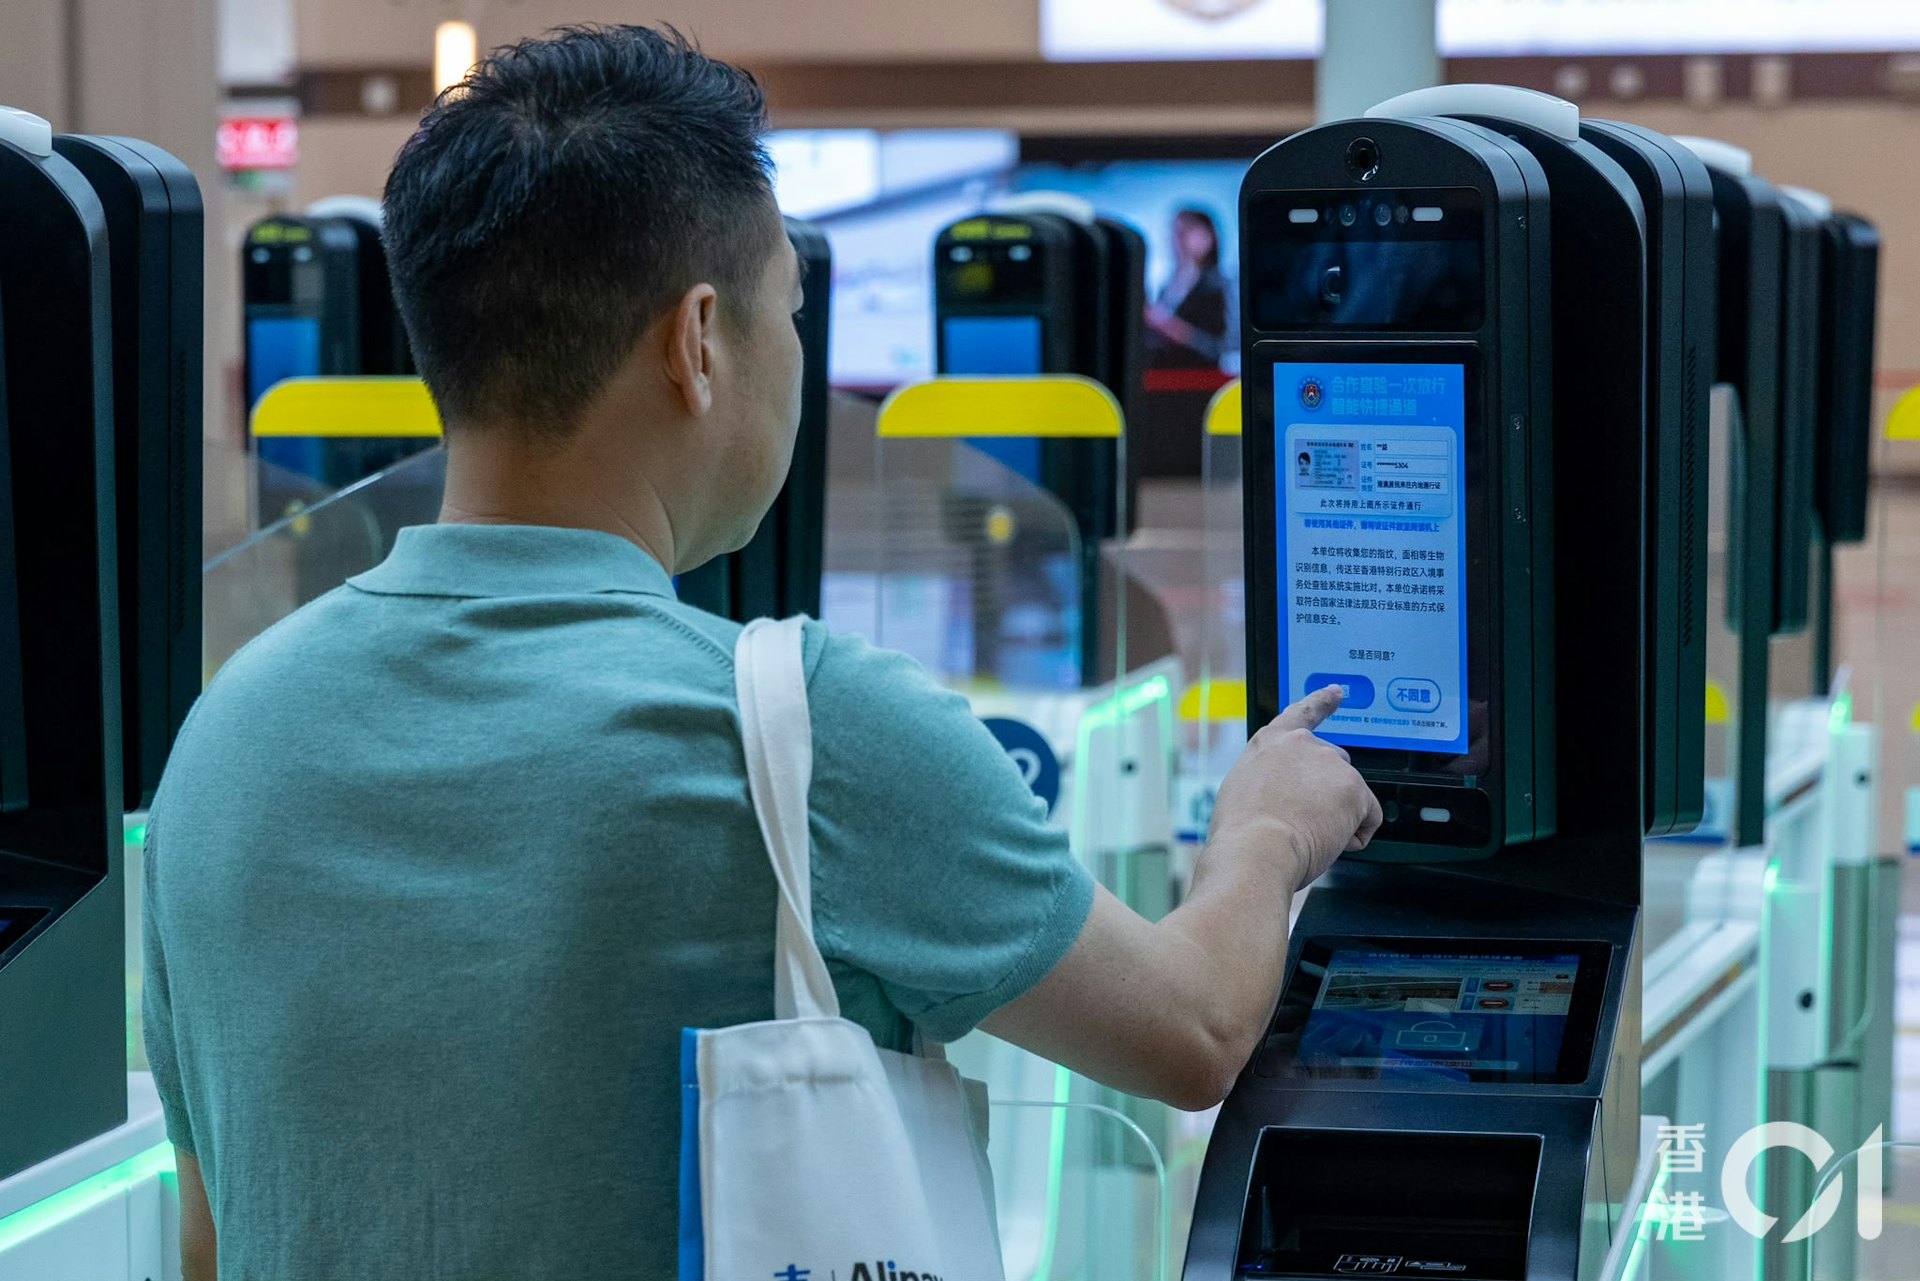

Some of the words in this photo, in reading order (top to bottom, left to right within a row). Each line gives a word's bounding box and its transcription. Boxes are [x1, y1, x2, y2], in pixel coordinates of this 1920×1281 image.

[1331, 376, 1446, 394] 合作查验一次放行
[1331, 398, 1417, 416] 智能快捷通道
[1296, 596, 1446, 613] 取符合国家法律法规及行业标准的方式保
[1296, 613, 1341, 626] 护信息安全。
[1396, 687, 1431, 704] 不同意
